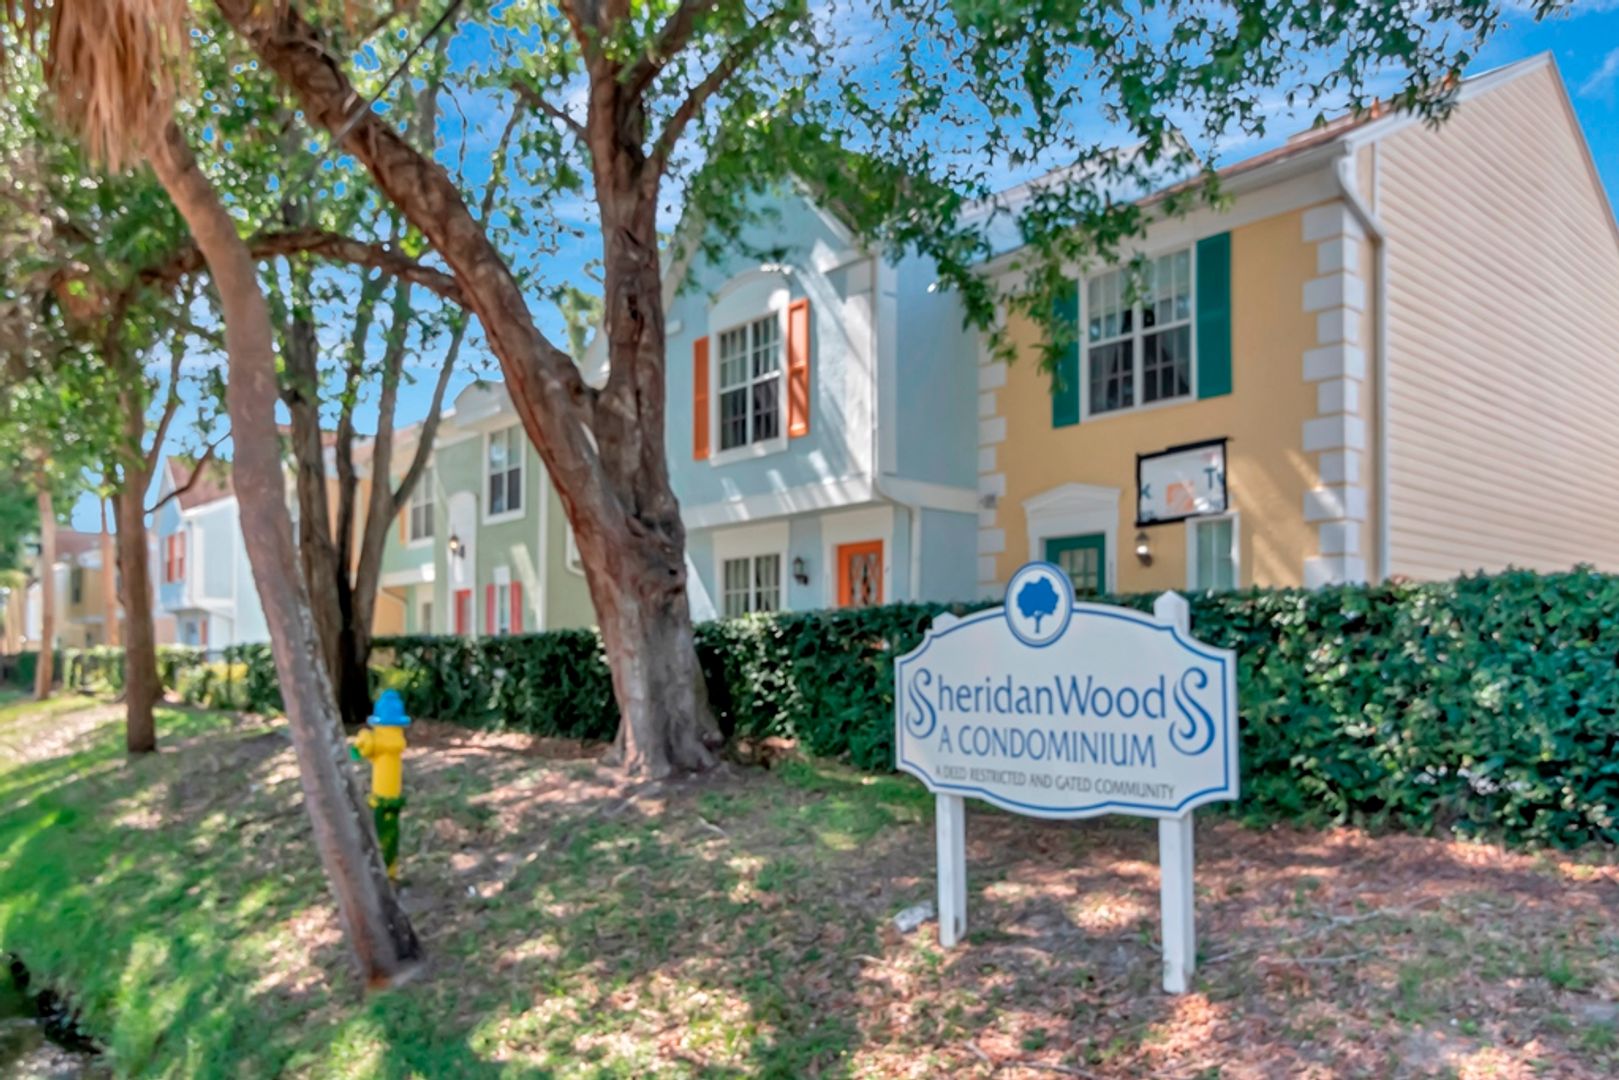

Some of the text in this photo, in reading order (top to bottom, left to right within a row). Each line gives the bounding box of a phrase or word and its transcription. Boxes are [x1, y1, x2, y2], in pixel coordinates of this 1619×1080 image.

[938, 725, 1157, 768] A CONDOMINIUM
[970, 767, 1026, 786] RESTRICTED
[1029, 773, 1052, 789] AND
[1055, 774, 1091, 792] GATED
[1094, 778, 1175, 799] COMMUNITY
